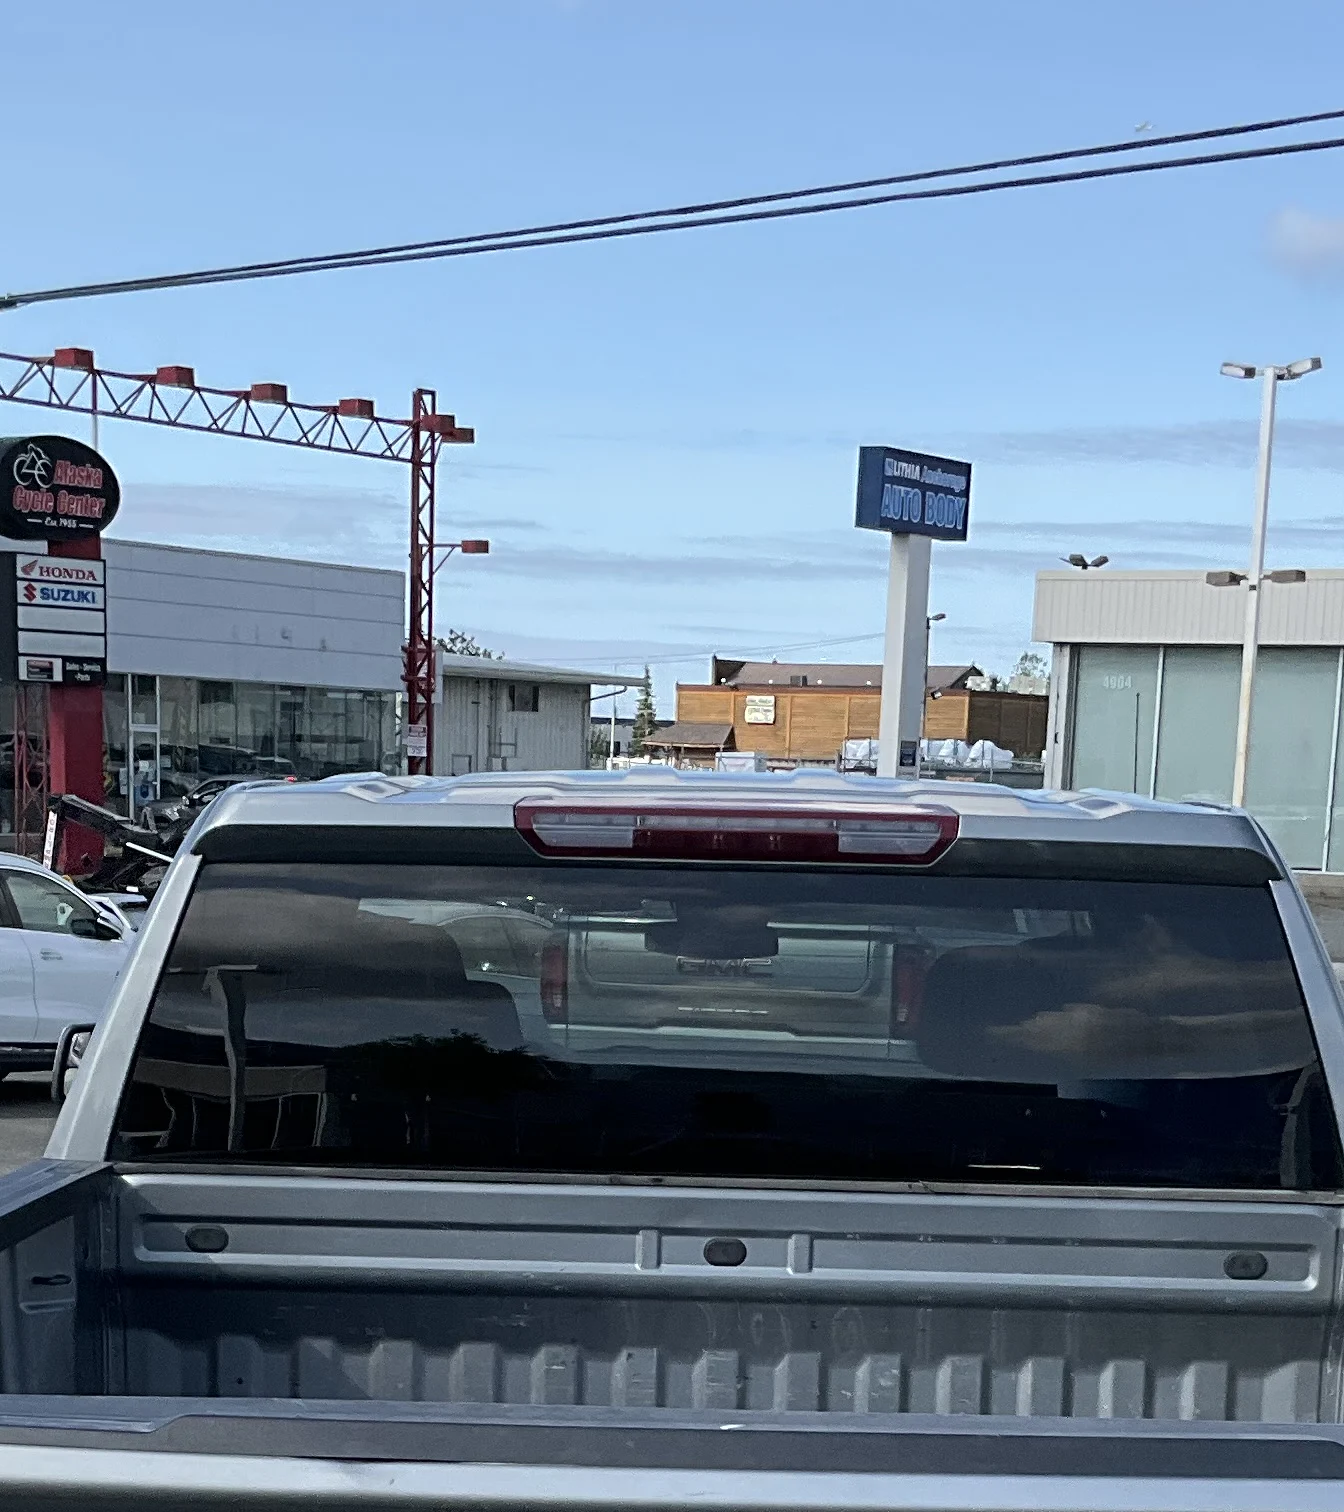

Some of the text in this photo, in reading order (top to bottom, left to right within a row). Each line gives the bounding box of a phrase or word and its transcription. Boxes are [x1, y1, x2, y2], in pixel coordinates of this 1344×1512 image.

[53, 460, 103, 489] Alaska
[893, 460, 920, 480] LITHIA
[12, 484, 106, 519] Cycle Center
[880, 483, 967, 530] AUTO BODY
[38, 565, 98, 582] HONDA
[39, 586, 97, 605] SUZUKI
